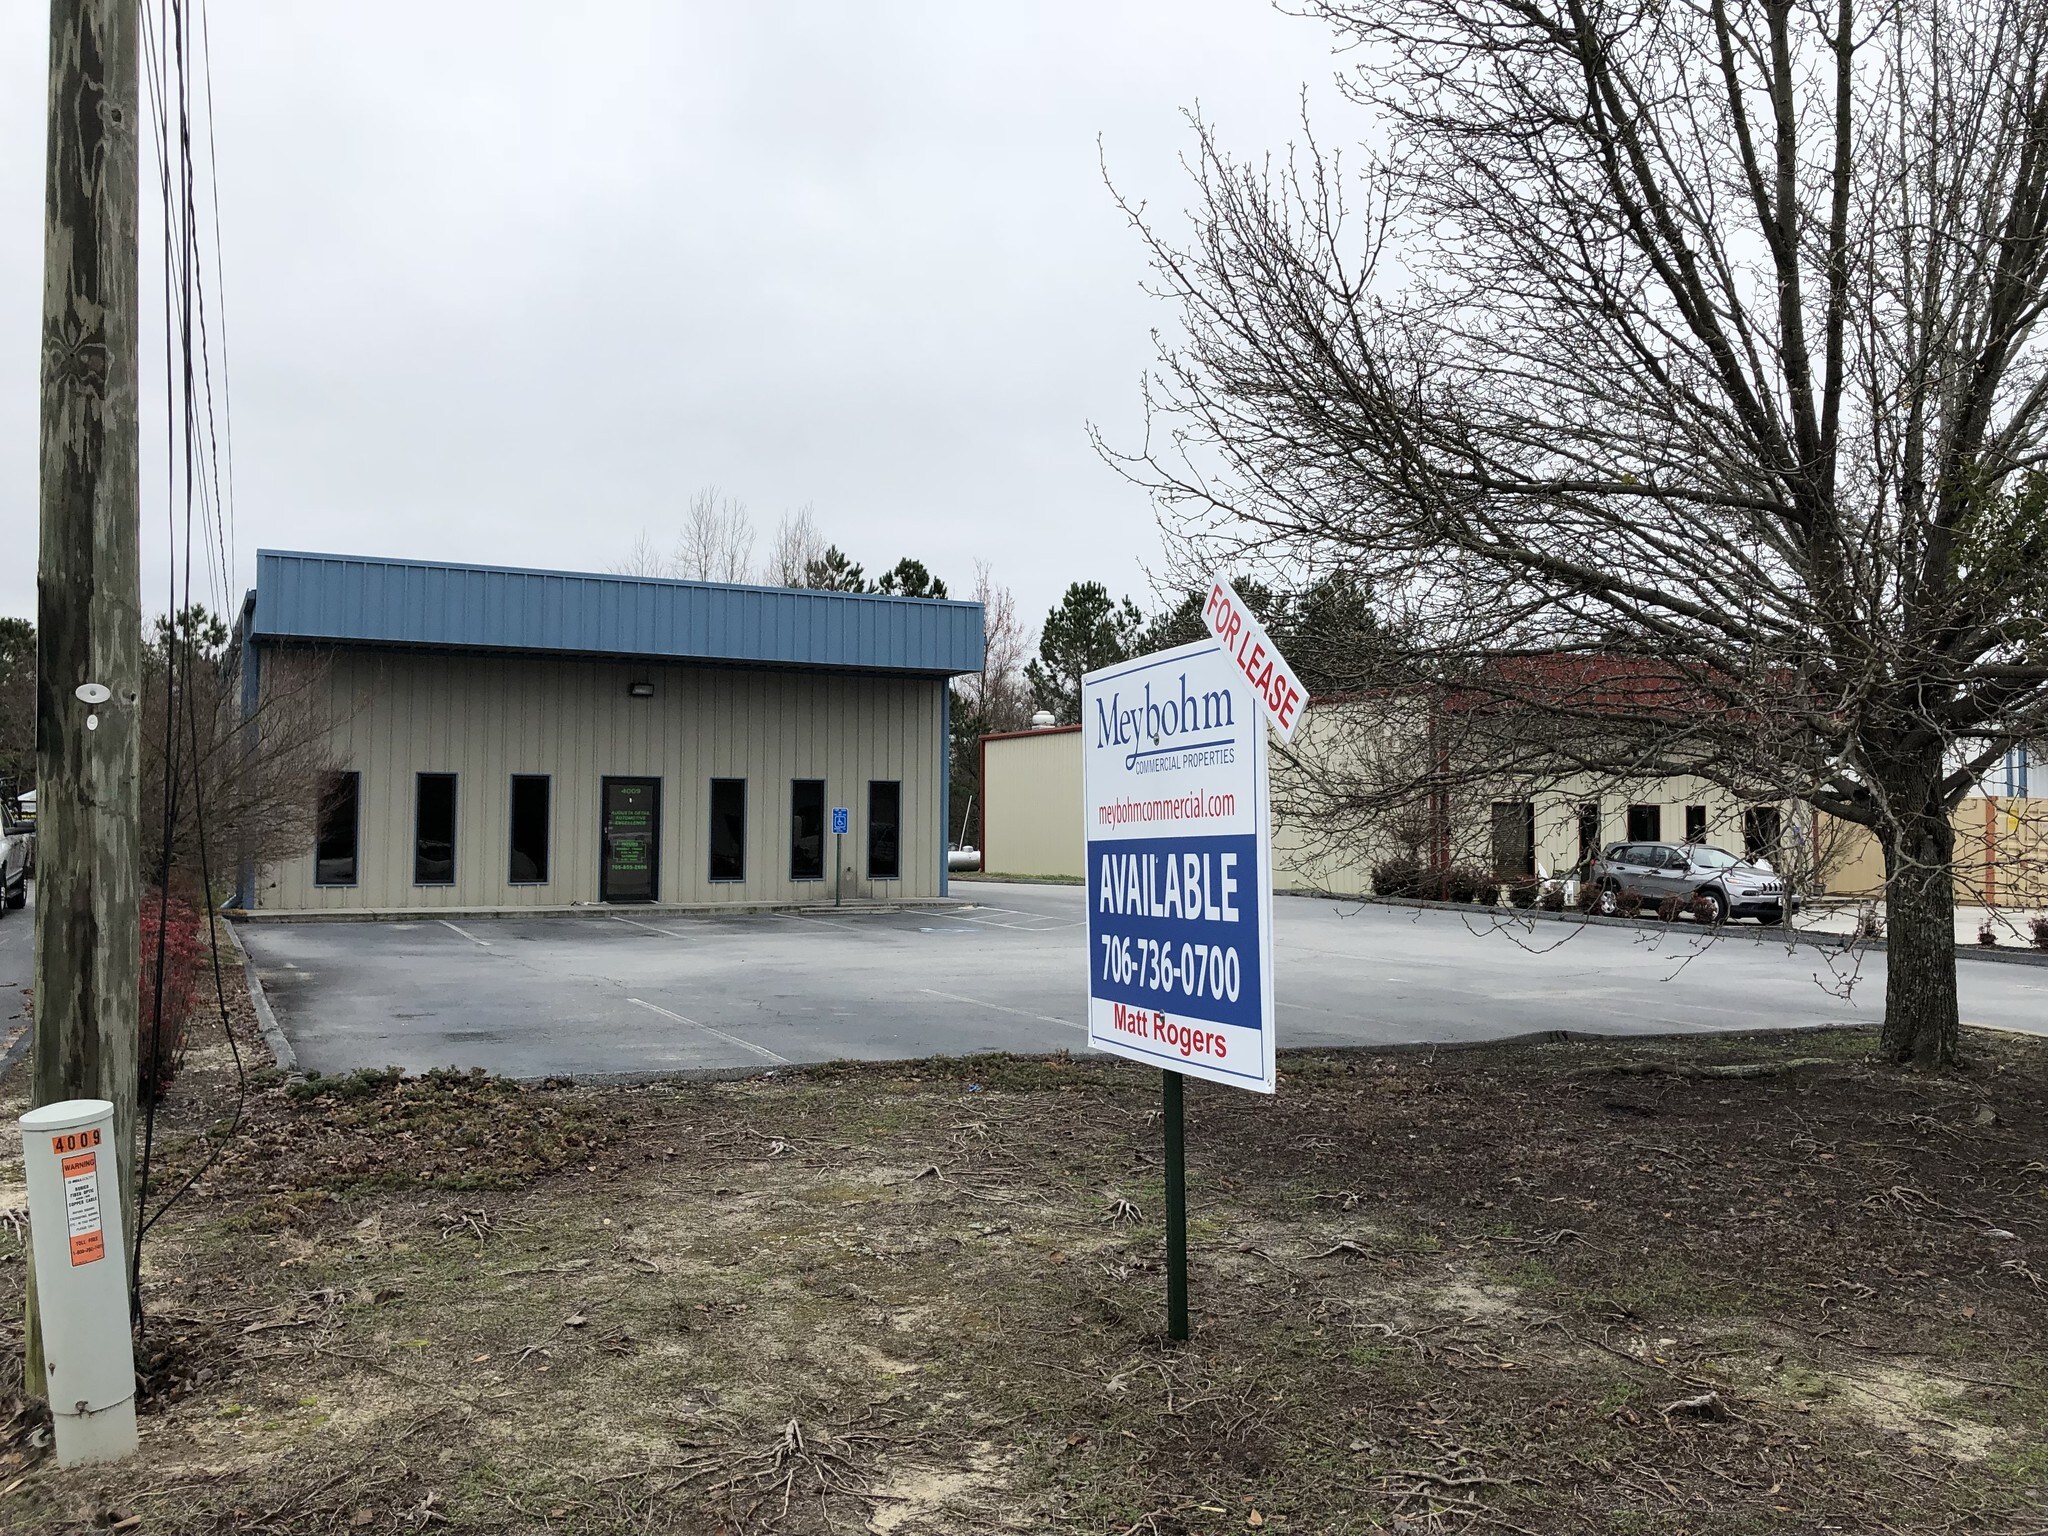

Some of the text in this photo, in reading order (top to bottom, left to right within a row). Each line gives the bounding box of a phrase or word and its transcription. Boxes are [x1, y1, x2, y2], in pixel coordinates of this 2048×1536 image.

[1206, 583, 1300, 730] FOR LEASE
[1096, 672, 1235, 768] Meybohm
[1135, 748, 1236, 775] COMMERCIAL PROPERTIES
[1099, 787, 1236, 831] meybohmcommercial.com
[1100, 852, 1240, 923] AVAILABLE
[1101, 934, 1240, 1003] 706-736-0700
[1114, 1003, 1228, 1059] Matt Rogers
[56, 1129, 100, 1152] 4009
[64, 1159, 95, 1171] WARNING
